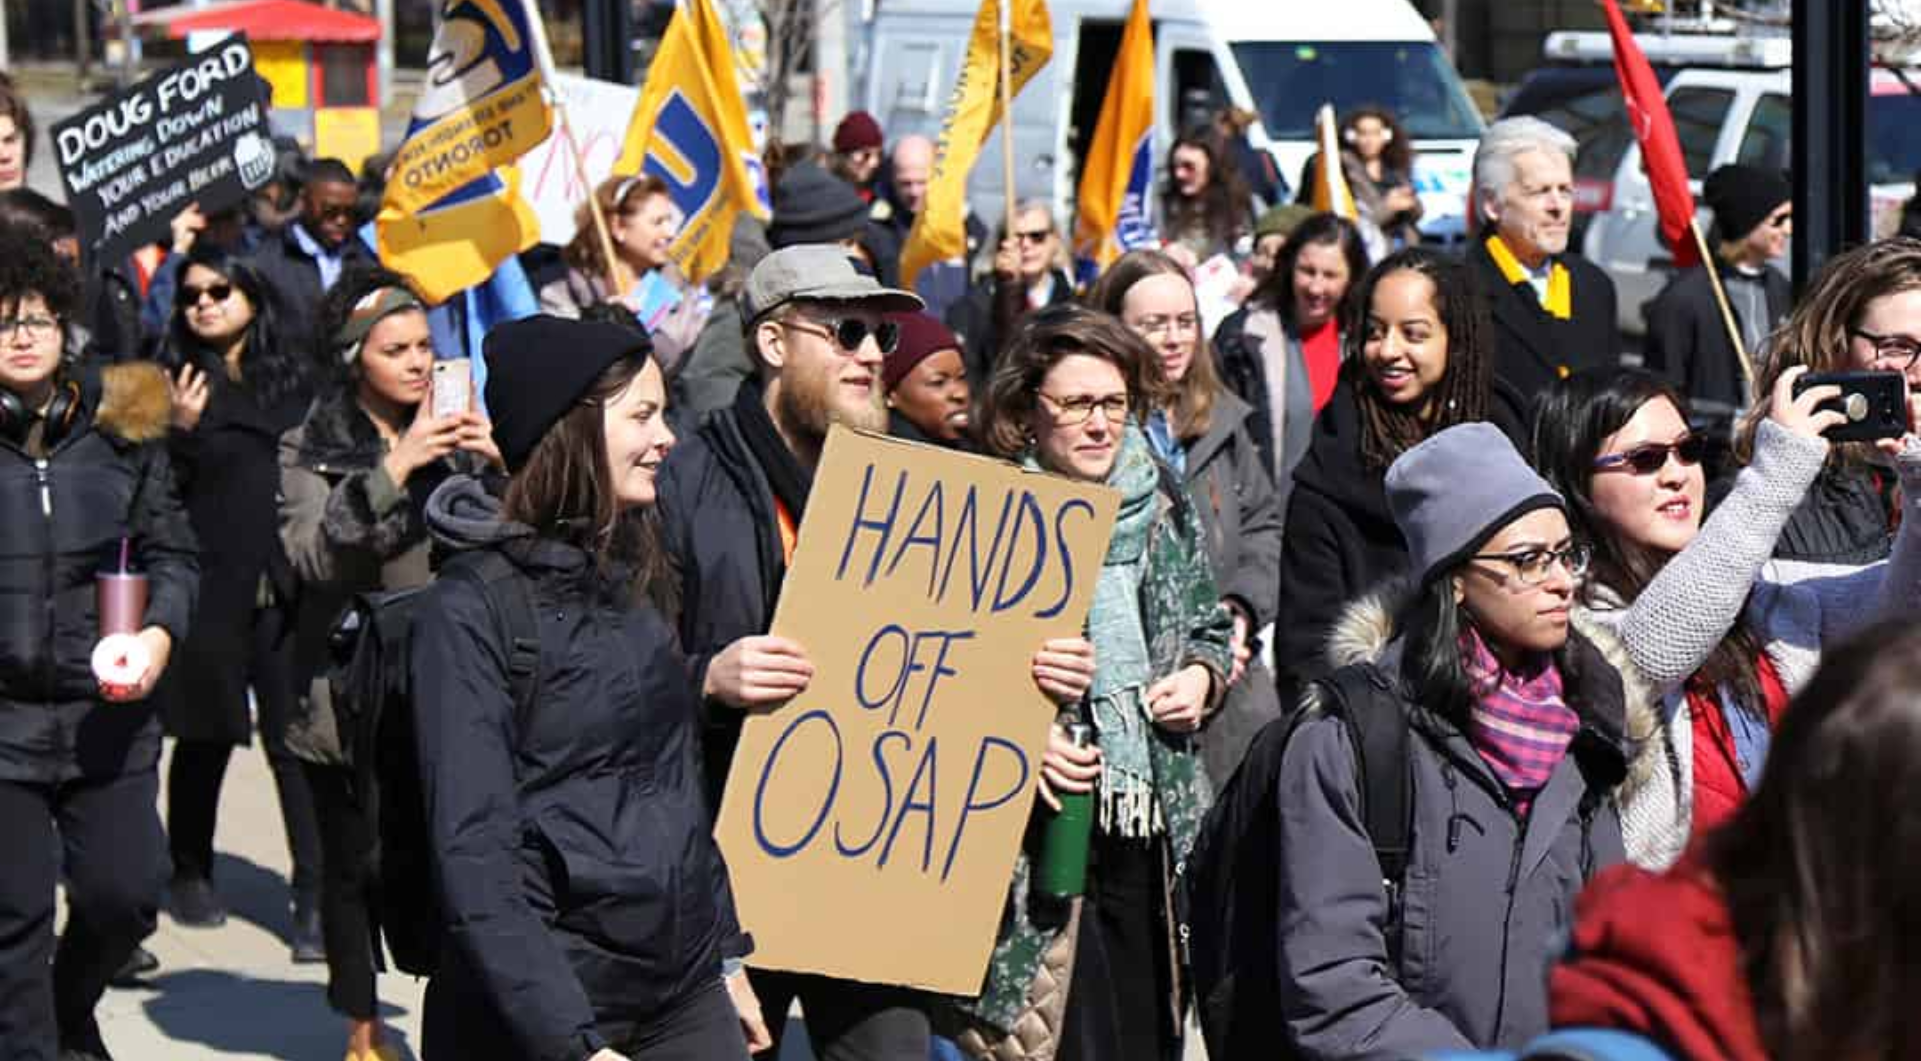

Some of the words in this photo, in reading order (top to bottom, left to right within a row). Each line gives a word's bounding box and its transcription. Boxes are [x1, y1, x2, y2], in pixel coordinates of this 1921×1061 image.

[57, 94, 152, 165] DOUG
[157, 44, 249, 112] FORD
[67, 136, 155, 194] WATERING
[156, 95, 222, 142] DOWN
[97, 166, 148, 208] YOUR
[150, 102, 258, 176] EDUCATION
[104, 204, 141, 240] AND
[141, 180, 187, 217] YOUR
[188, 154, 235, 190] BEER
[836, 464, 1095, 620] HANDS
[855, 623, 976, 731] OFF
[752, 708, 1030, 884] OSAP
